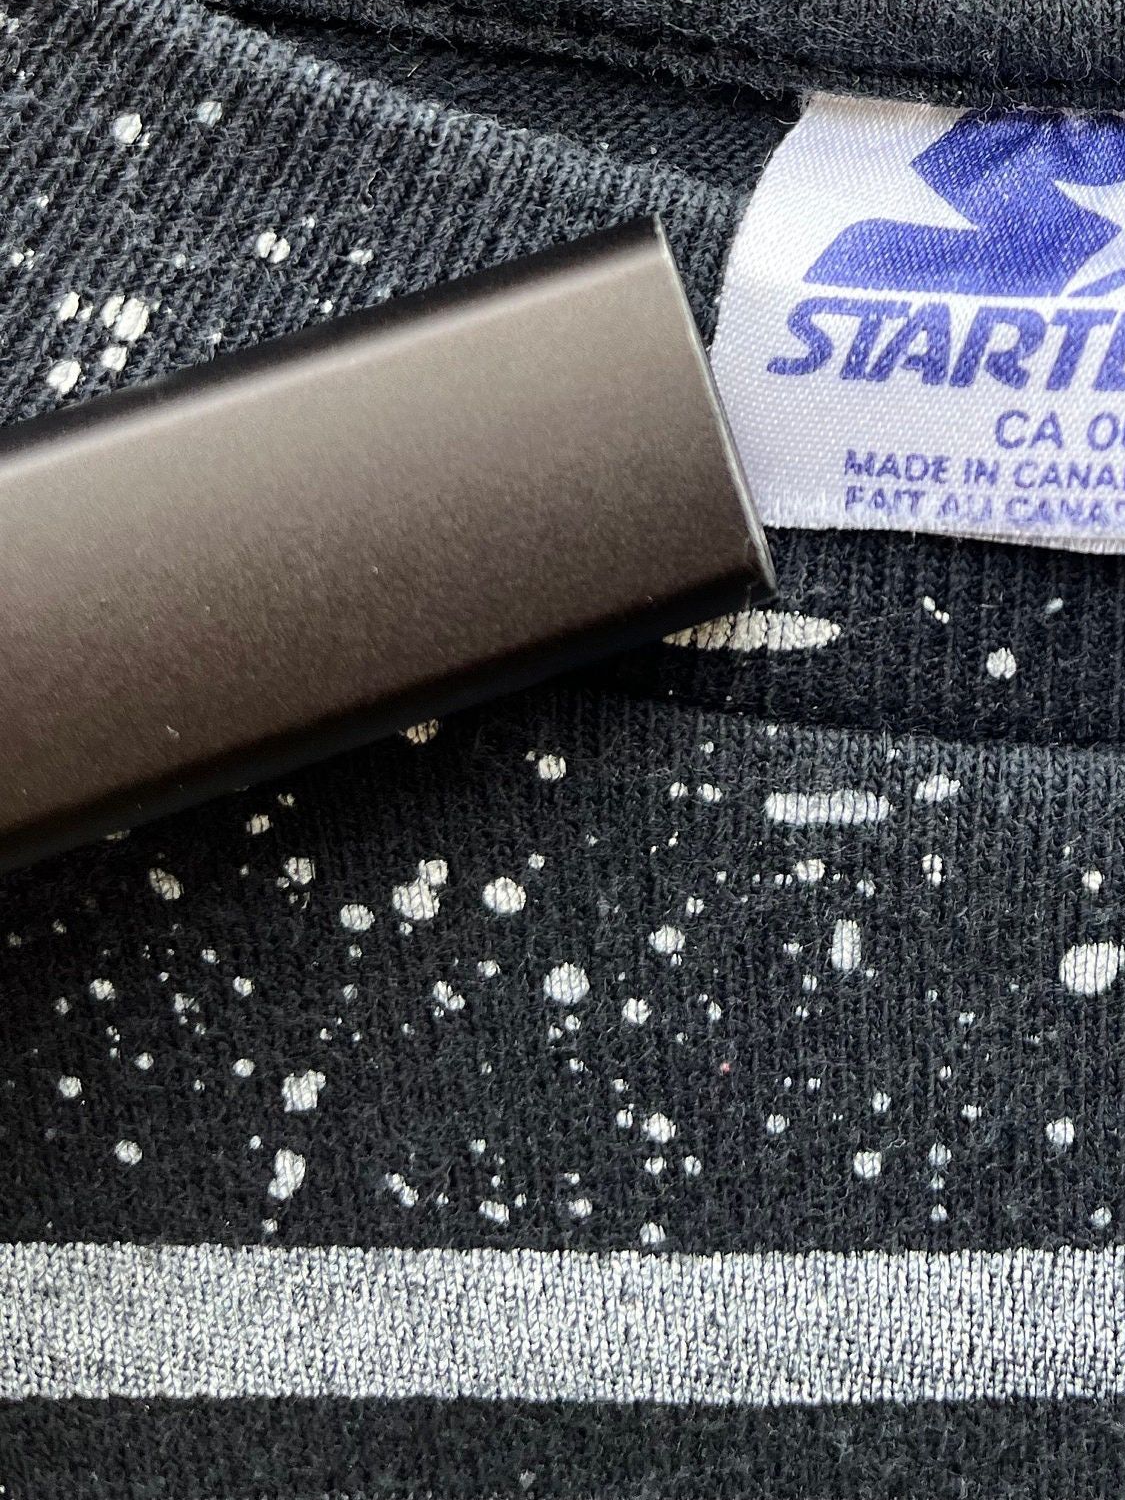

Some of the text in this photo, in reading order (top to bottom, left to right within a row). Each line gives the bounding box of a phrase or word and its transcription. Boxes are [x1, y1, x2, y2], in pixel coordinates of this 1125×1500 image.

[994, 410, 1064, 450] CA
[844, 449, 951, 485] MADE
[963, 457, 999, 486] IN
[845, 486, 926, 516] FAIT
[936, 493, 993, 522] AU
